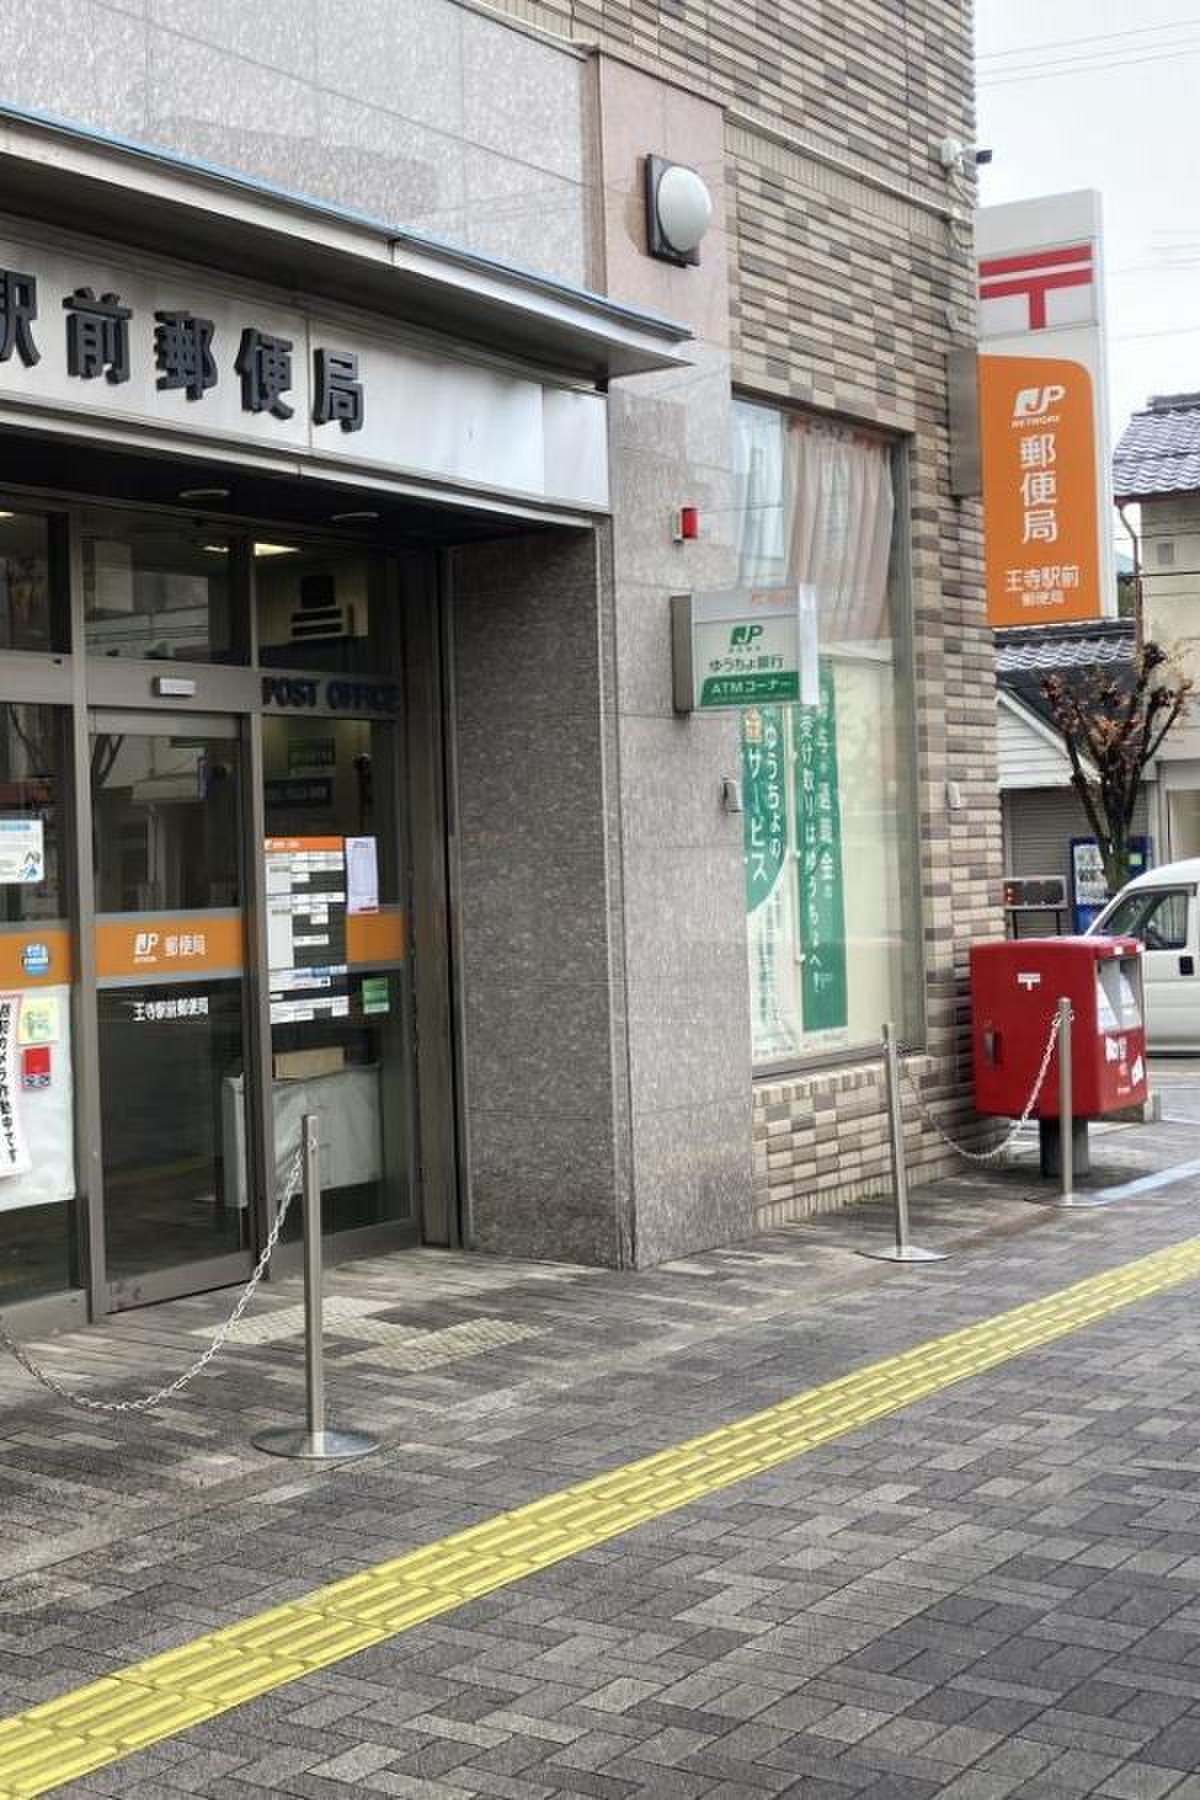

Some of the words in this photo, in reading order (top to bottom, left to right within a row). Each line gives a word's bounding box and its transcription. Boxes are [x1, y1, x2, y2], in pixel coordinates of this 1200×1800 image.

[1019, 434, 1058, 545] 郵便局
[1004, 565, 1080, 593] 王寺駅前
[711, 678, 794, 694] ATMコーナー
